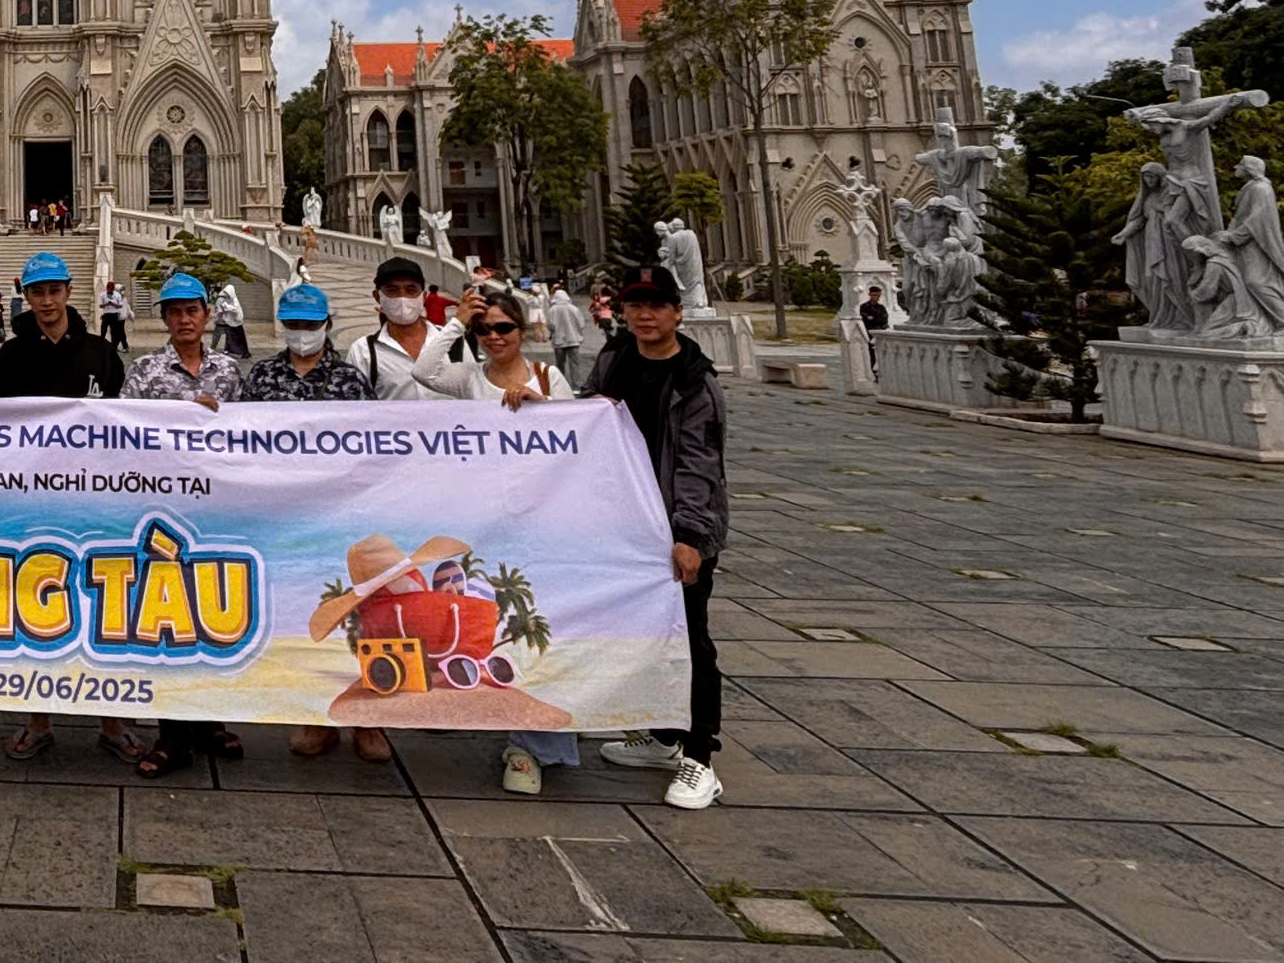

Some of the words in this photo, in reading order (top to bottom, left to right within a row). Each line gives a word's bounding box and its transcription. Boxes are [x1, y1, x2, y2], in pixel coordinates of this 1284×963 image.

[19, 424, 162, 451] MACHINE
[167, 428, 413, 455] TECHNOLOGIES
[418, 424, 491, 462] VIỆT
[498, 429, 579, 455] NAM
[34, 468, 86, 491] NGHỈ
[92, 471, 172, 495] DƯỠNG
[177, 477, 211, 500] TẠI
[91, 526, 251, 645] TÀU
